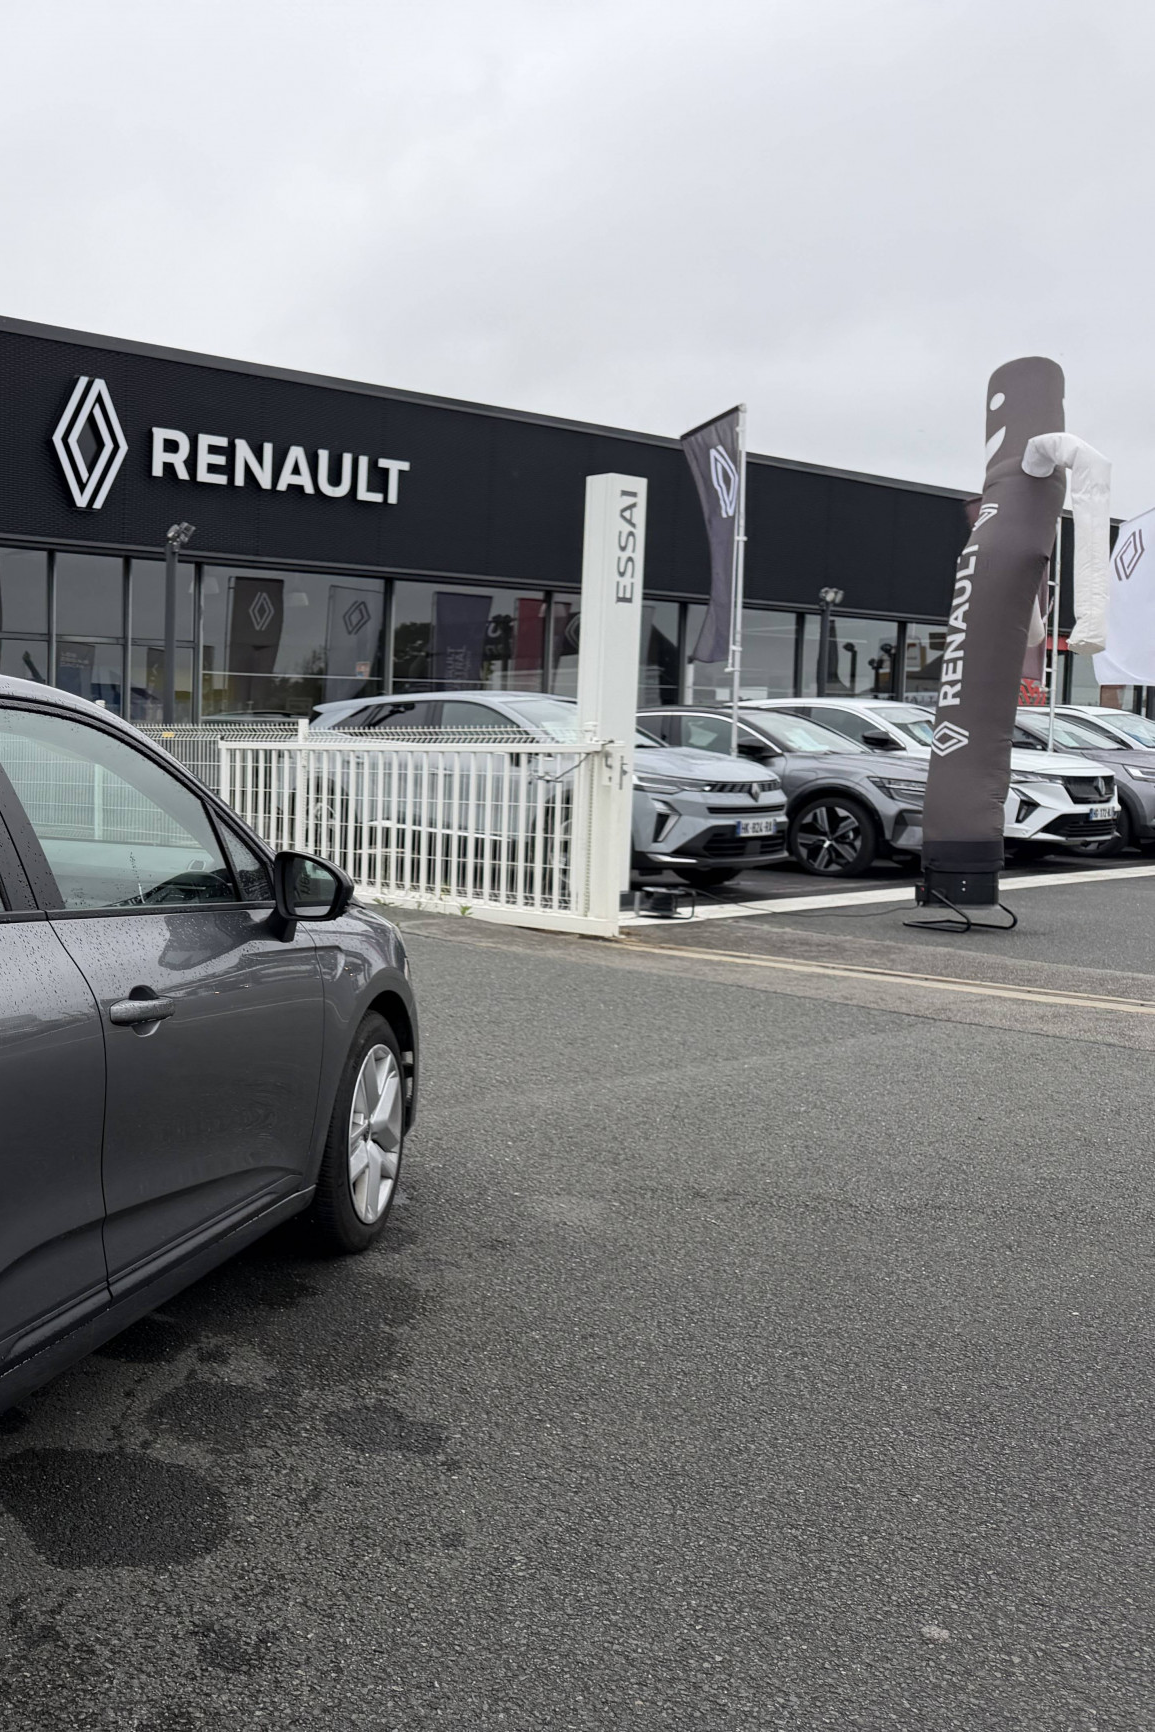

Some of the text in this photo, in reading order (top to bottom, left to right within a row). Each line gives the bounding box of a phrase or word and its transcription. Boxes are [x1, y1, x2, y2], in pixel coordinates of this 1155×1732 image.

[151, 427, 411, 504] RENAULT
[615, 490, 638, 604] ESSAI
[938, 544, 979, 707] RENAULT
